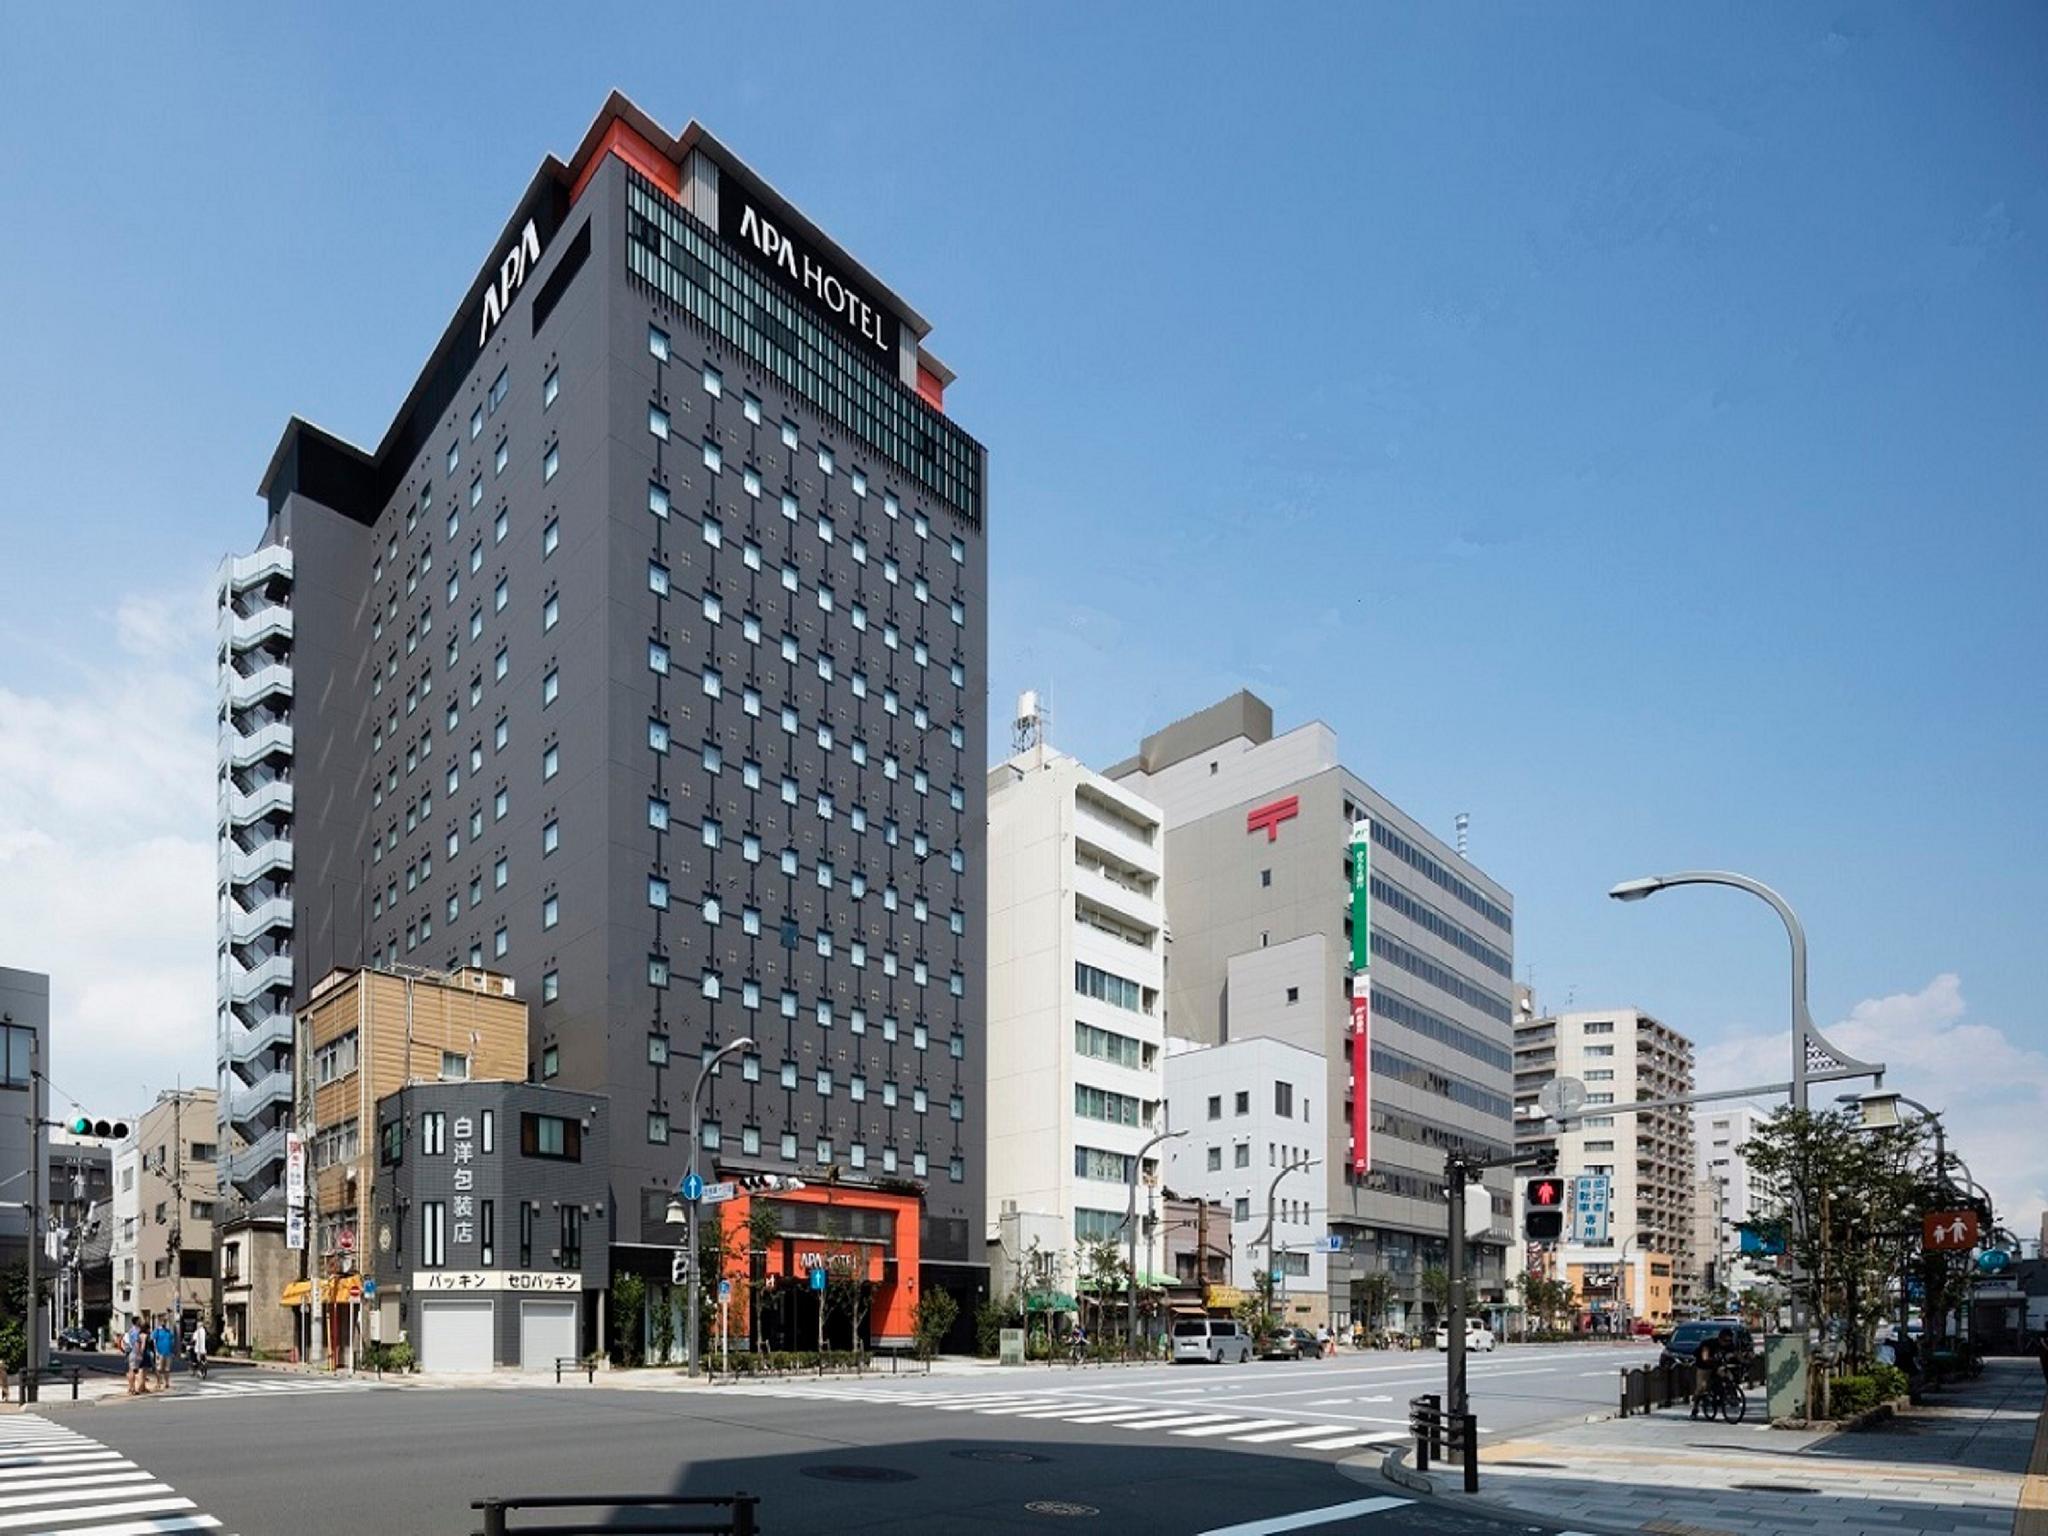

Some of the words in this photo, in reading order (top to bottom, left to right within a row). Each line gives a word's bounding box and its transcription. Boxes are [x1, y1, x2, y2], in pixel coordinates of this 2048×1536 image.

[479, 217, 540, 348] APA
[740, 204, 798, 279] APA
[803, 254, 888, 351] HOTEL
[453, 1116, 474, 1244] 白洋包装店
